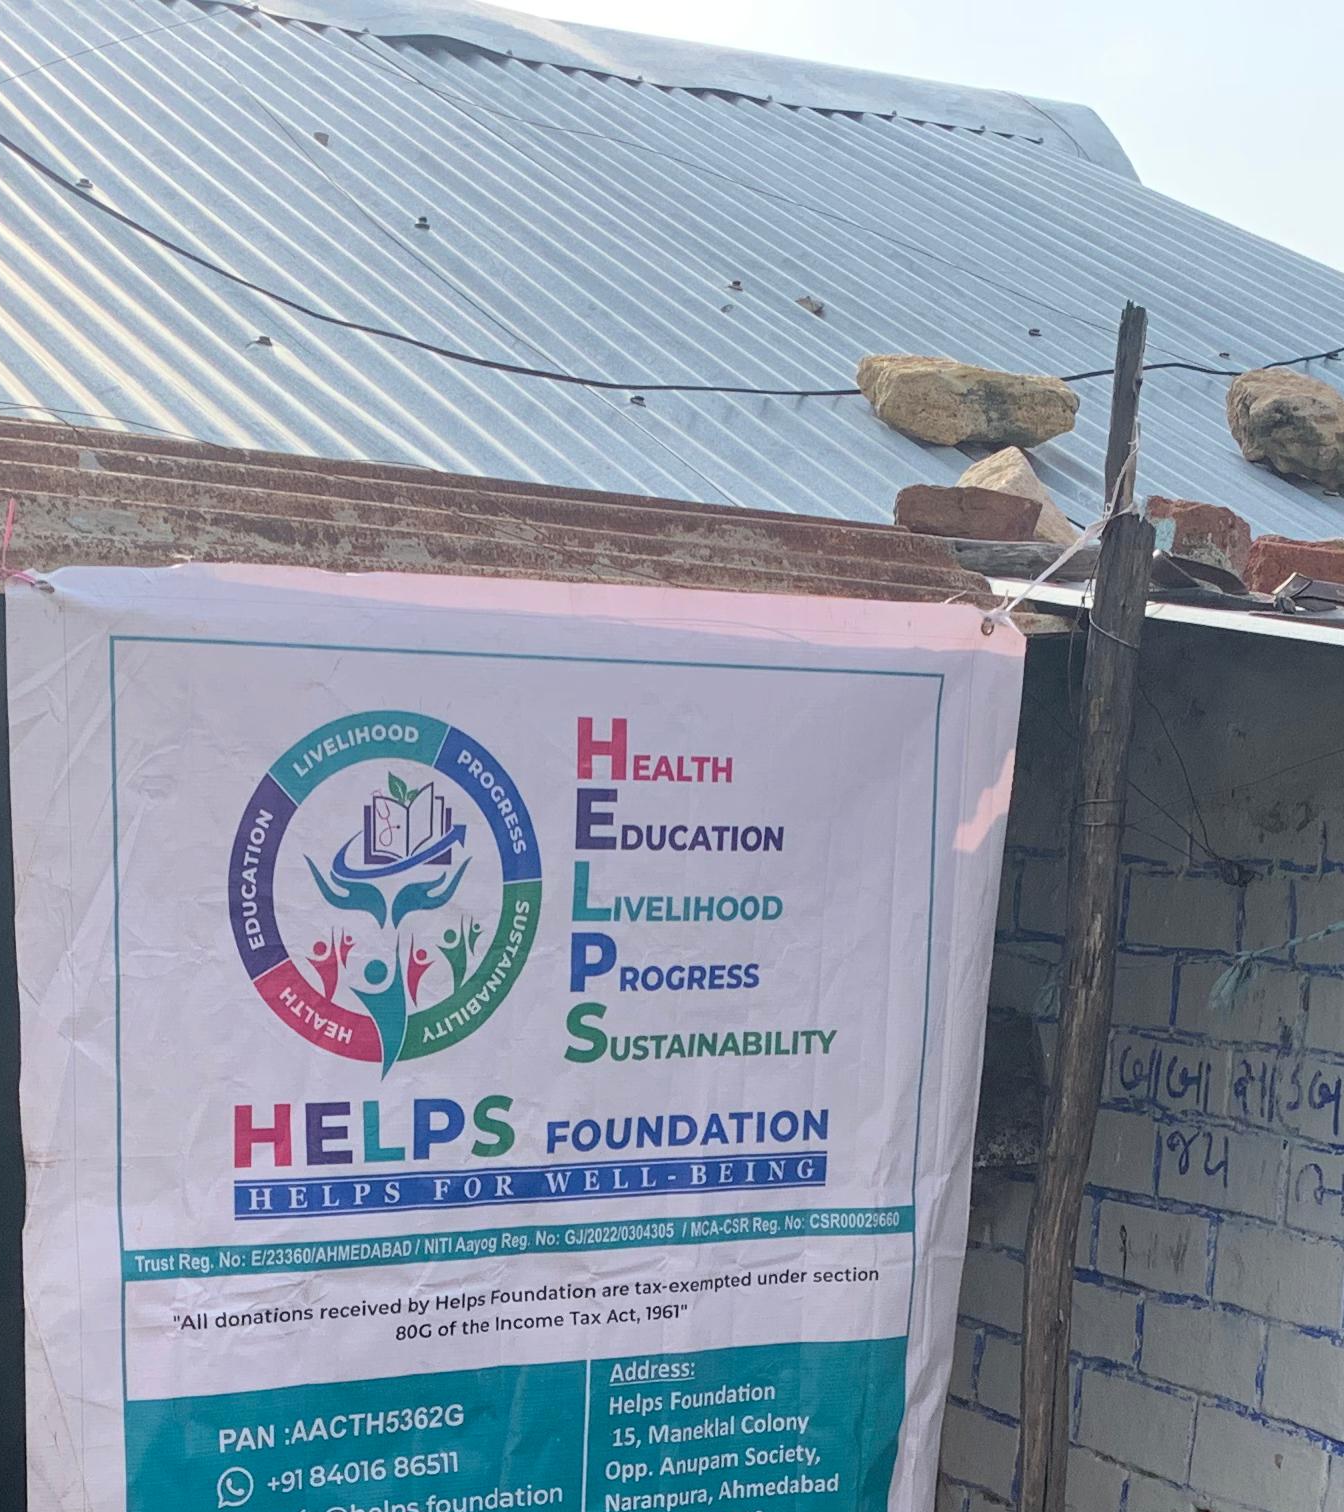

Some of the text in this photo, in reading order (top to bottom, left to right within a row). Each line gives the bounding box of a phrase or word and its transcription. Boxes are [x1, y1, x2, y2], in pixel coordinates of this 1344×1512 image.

[292, 723, 420, 778] LIVELIHOOD
[576, 716, 734, 784] HEALTH
[457, 749, 528, 855] PROGRESS
[574, 787, 785, 852] EDUCATION
[240, 809, 275, 951] EDUCATION
[571, 860, 785, 923] LIVELIHOOD
[421, 899, 531, 1045] SUSTAINABILITY
[569, 931, 761, 993] PROGRESS
[278, 986, 354, 1045] HEALTH
[563, 1001, 839, 1064] SUSTAINABILITY
[233, 1094, 830, 1169] HELPS FOUNDATION
[248, 1181, 401, 1212] HELPS
[433, 1175, 515, 1201] FOR
[134, 1254, 175, 1273] Trust
[178, 1252, 214, 1273] Reg.
[218, 1251, 247, 1268] No:
[251, 1240, 412, 1267] E/23360/AHMEDABAD
[424, 1237, 452, 1255] NITI
[455, 1235, 497, 1256] Aayog
[500, 1232, 531, 1251] Reg.
[535, 1230, 561, 1246] No:
[564, 1222, 675, 1246] GJ/2022/0304305
[690, 1217, 750, 1237] MCA-CSR
[752, 1215, 782, 1235] Reg.
[784, 1214, 807, 1230] No:
[809, 1211, 901, 1230] CSR00029660
[173, 1266, 880, 1331] "All donations received by Helps Foundation are tax-exempted under section
[395, 1304, 689, 1342] 80G of the Income Tax Act, 1961"
[609, 1360, 696, 1384] Address:
[609, 1383, 777, 1417] Helps Foundation
[218, 1424, 276, 1454] PAN
[612, 1412, 810, 1449] 15, Maneklal Colony
[267, 1451, 460, 1493] +91 84016 86511
[605, 1444, 822, 1484] Opp. Anupam Society,
[718, 1472, 840, 1501] Ahmedabad
